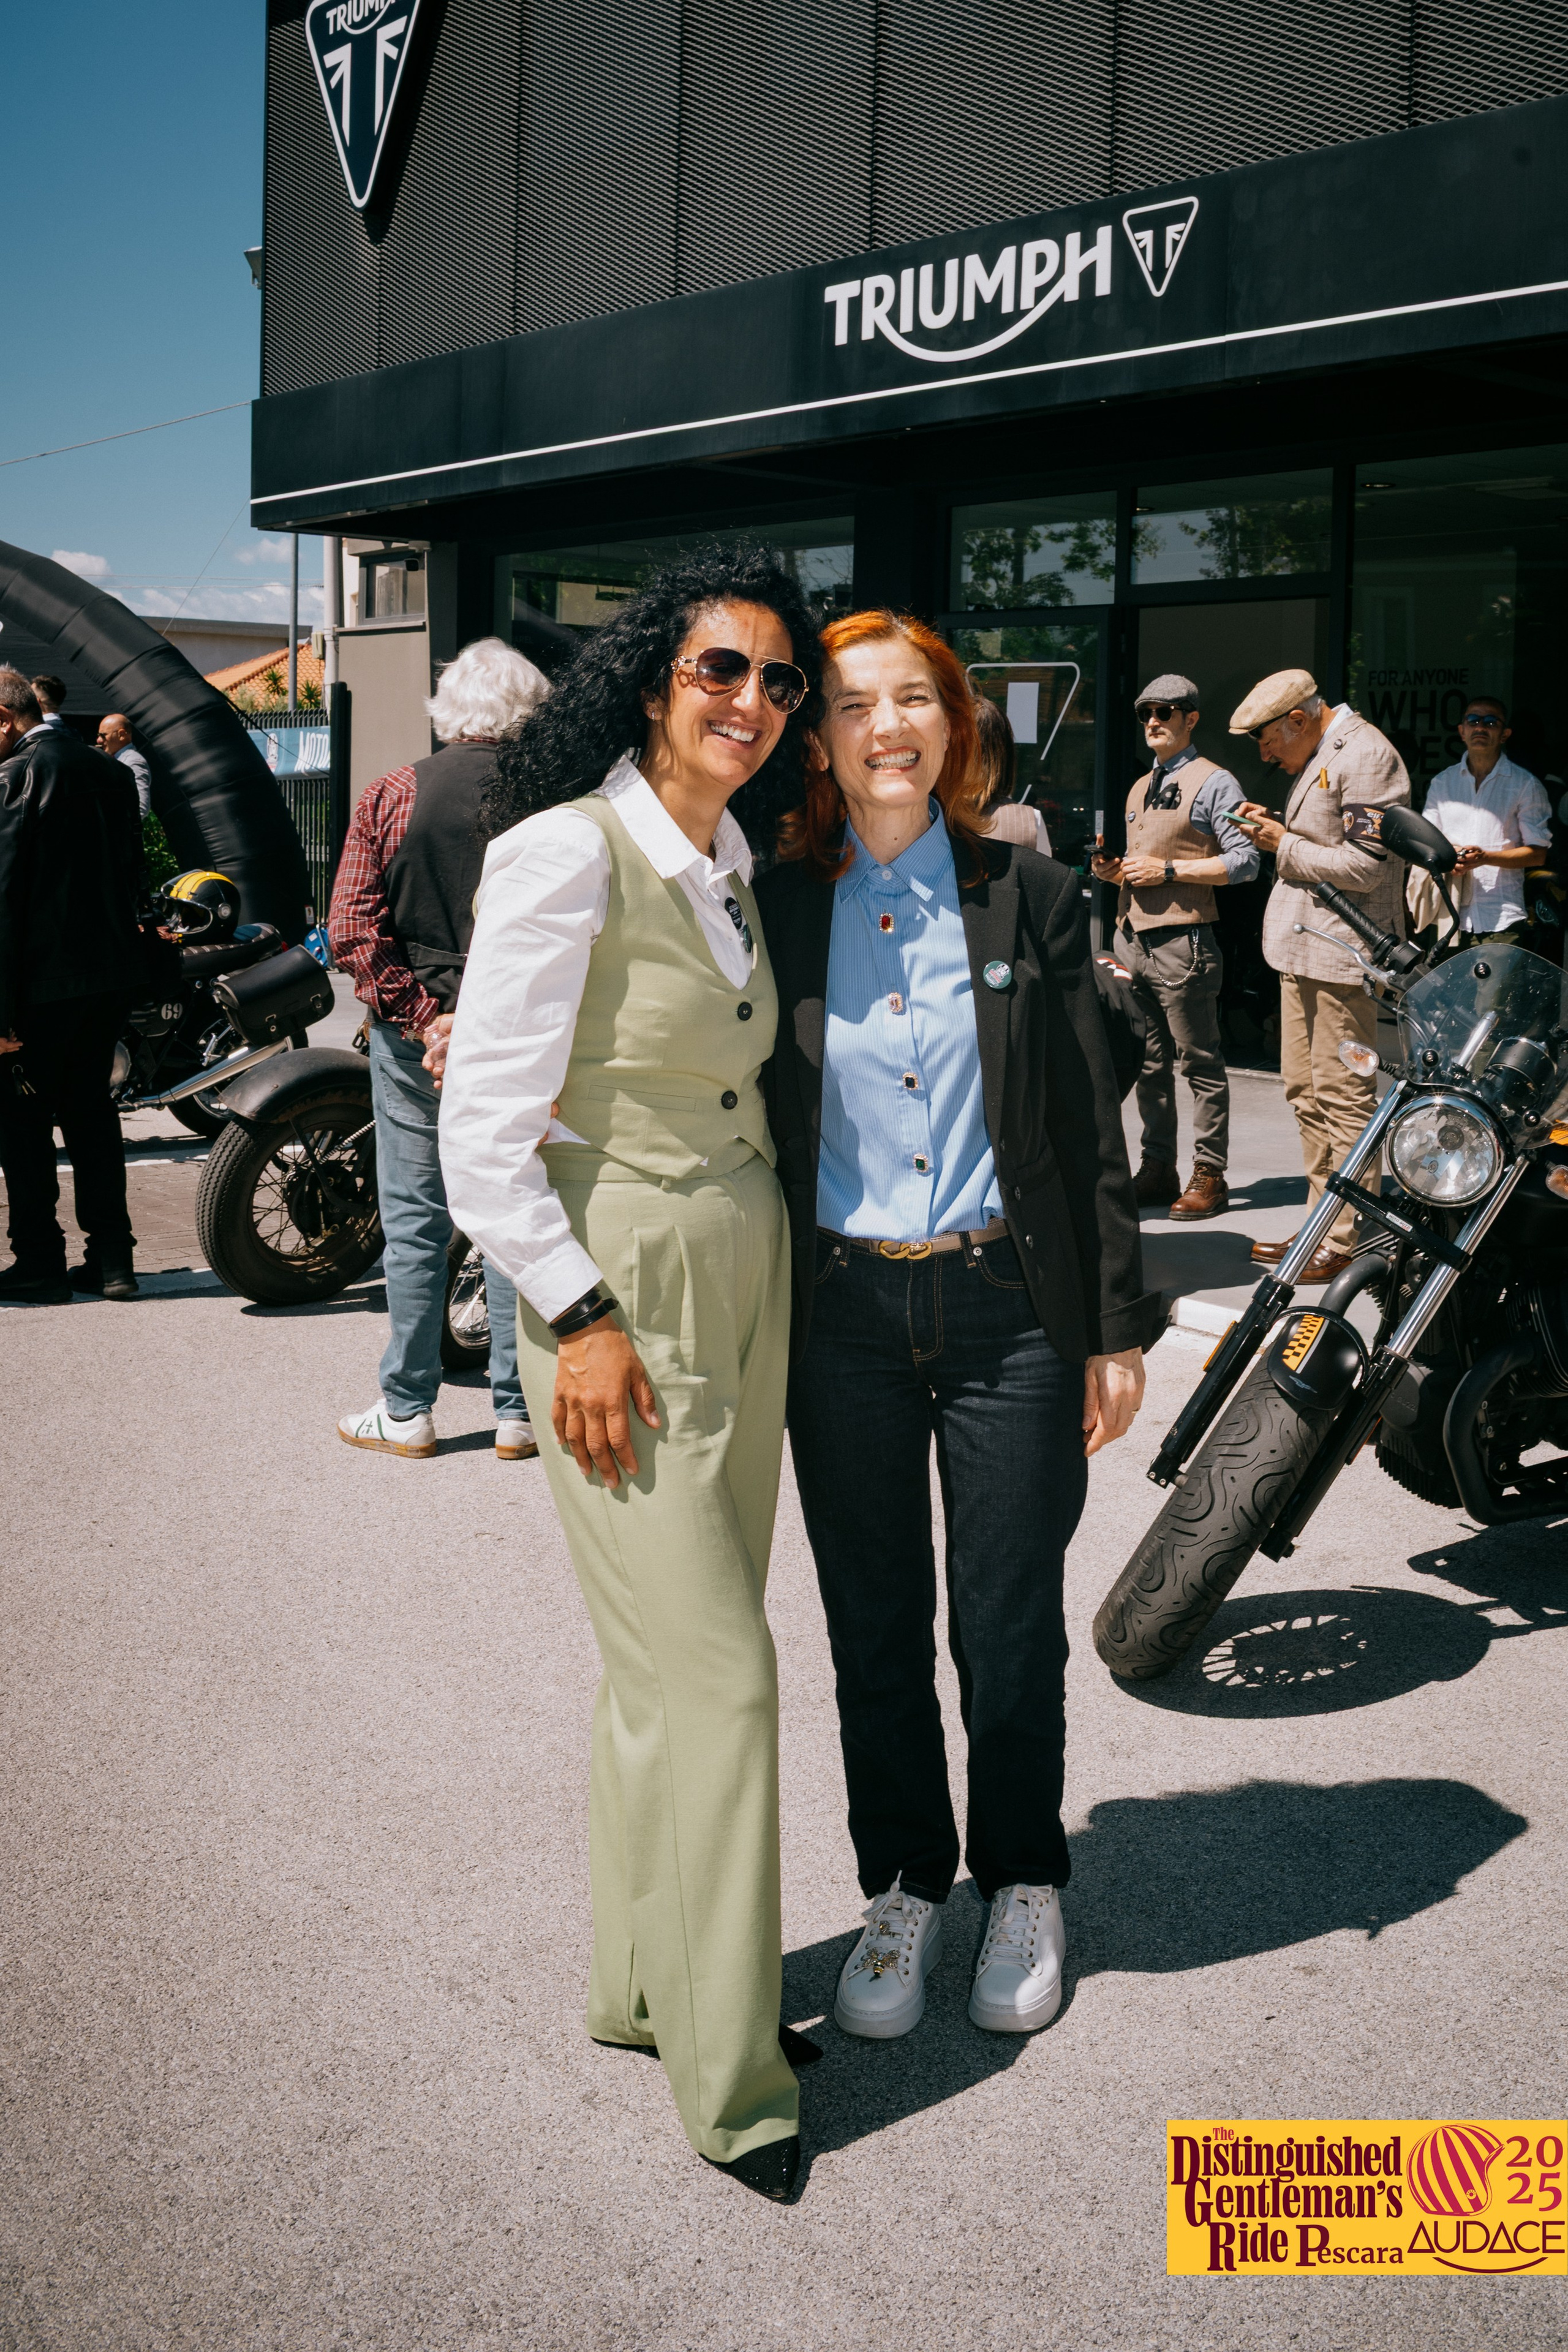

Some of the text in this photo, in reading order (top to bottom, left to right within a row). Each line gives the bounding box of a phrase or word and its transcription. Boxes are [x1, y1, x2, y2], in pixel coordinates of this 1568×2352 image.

[326, 0, 396, 34] TRIUM
[825, 225, 1112, 361] TRIUMPH
[1368, 668, 1469, 686] FOR ANYONE
[1368, 689, 1468, 733] WHO
[295, 731, 330, 774] MOTO
[161, 1003, 183, 1020] 69
